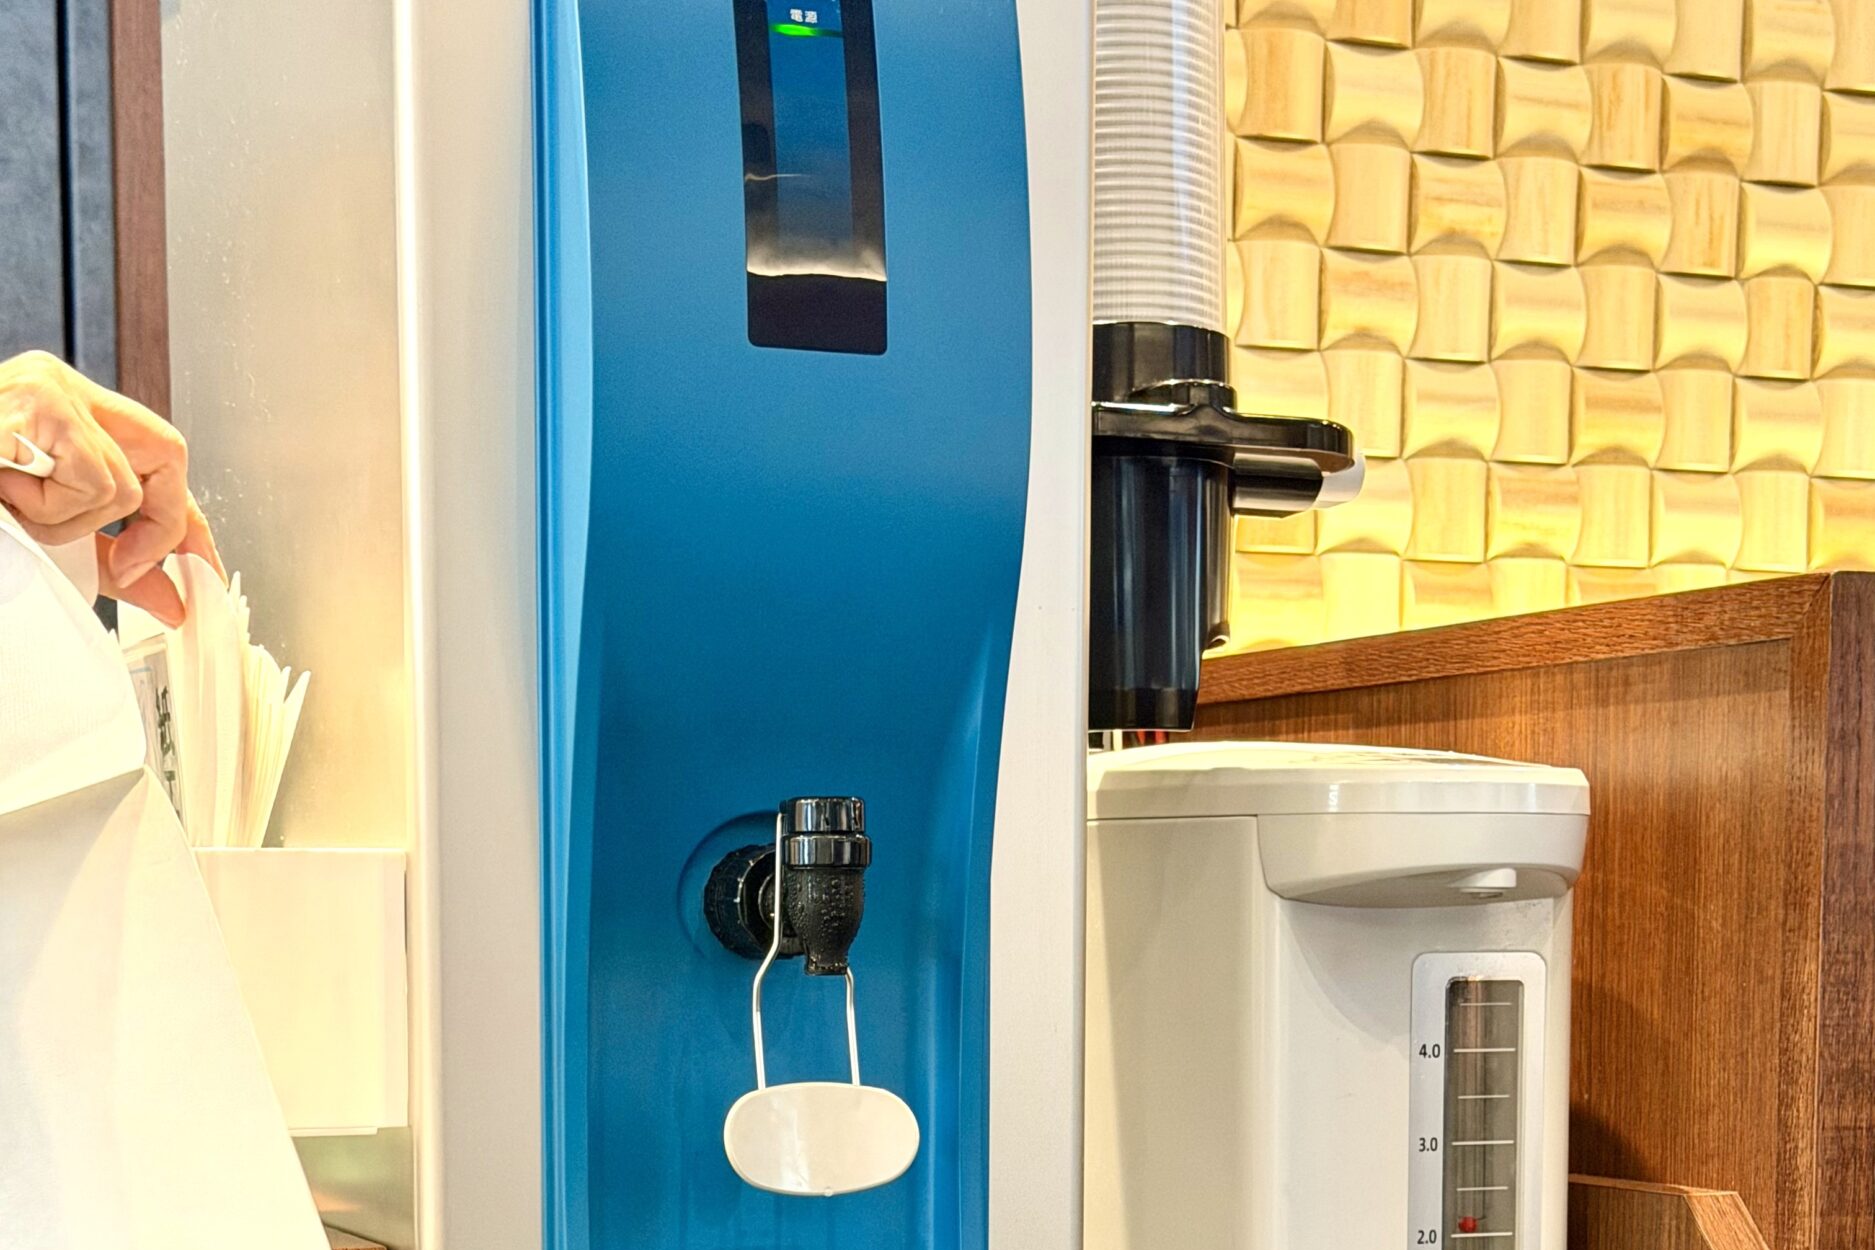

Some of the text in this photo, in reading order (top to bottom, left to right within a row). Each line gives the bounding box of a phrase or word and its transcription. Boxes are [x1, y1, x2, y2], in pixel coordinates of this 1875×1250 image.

[790, 8, 818, 23] 電源
[1419, 1043, 1441, 1059] 4.0
[1418, 1137, 1438, 1153] 3.0
[1417, 1230, 1437, 1245] 2.0
